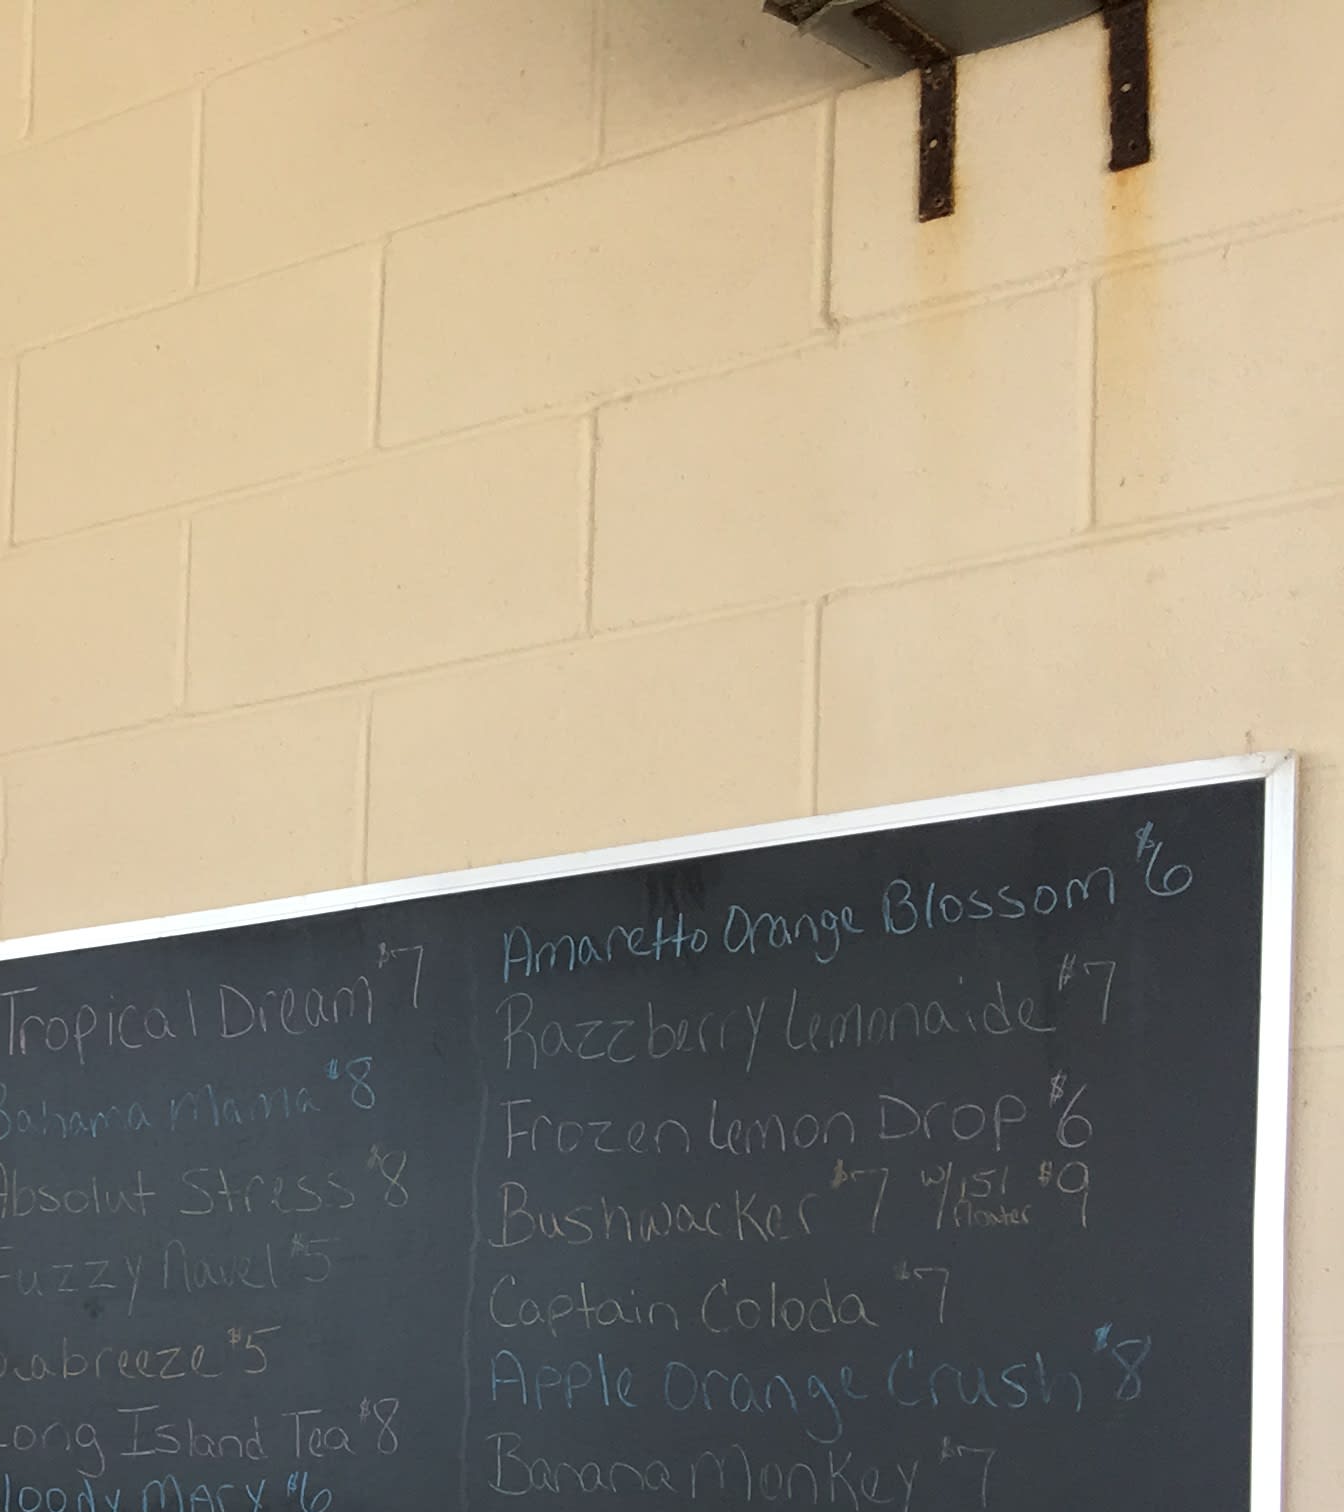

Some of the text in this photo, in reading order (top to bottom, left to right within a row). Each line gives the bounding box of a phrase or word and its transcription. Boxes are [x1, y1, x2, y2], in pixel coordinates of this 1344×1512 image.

[500, 822, 1193, 983] Amaretto Orange Blossom $6
[219, 976, 373, 1038] Dream
[497, 987, 768, 1073] Razzberry
[325, 1056, 376, 1109] $8
[499, 1098, 691, 1159] Frozen
[879, 1094, 1027, 1151] Drop
[1048, 1071, 1094, 1149] $6
[178, 1167, 356, 1214] Stress
[1038, 1160, 1090, 1229] $9
[489, 1274, 680, 1338] Captain
[226, 1325, 281, 1374] $5
[664, 1360, 868, 1444] Orange
[887, 1348, 1084, 1413] Crush
[1092, 1321, 1153, 1402] $8
[117, 1404, 269, 1460] Island
[282, 1408, 356, 1459] Tea
[486, 1431, 677, 1496] Banana
